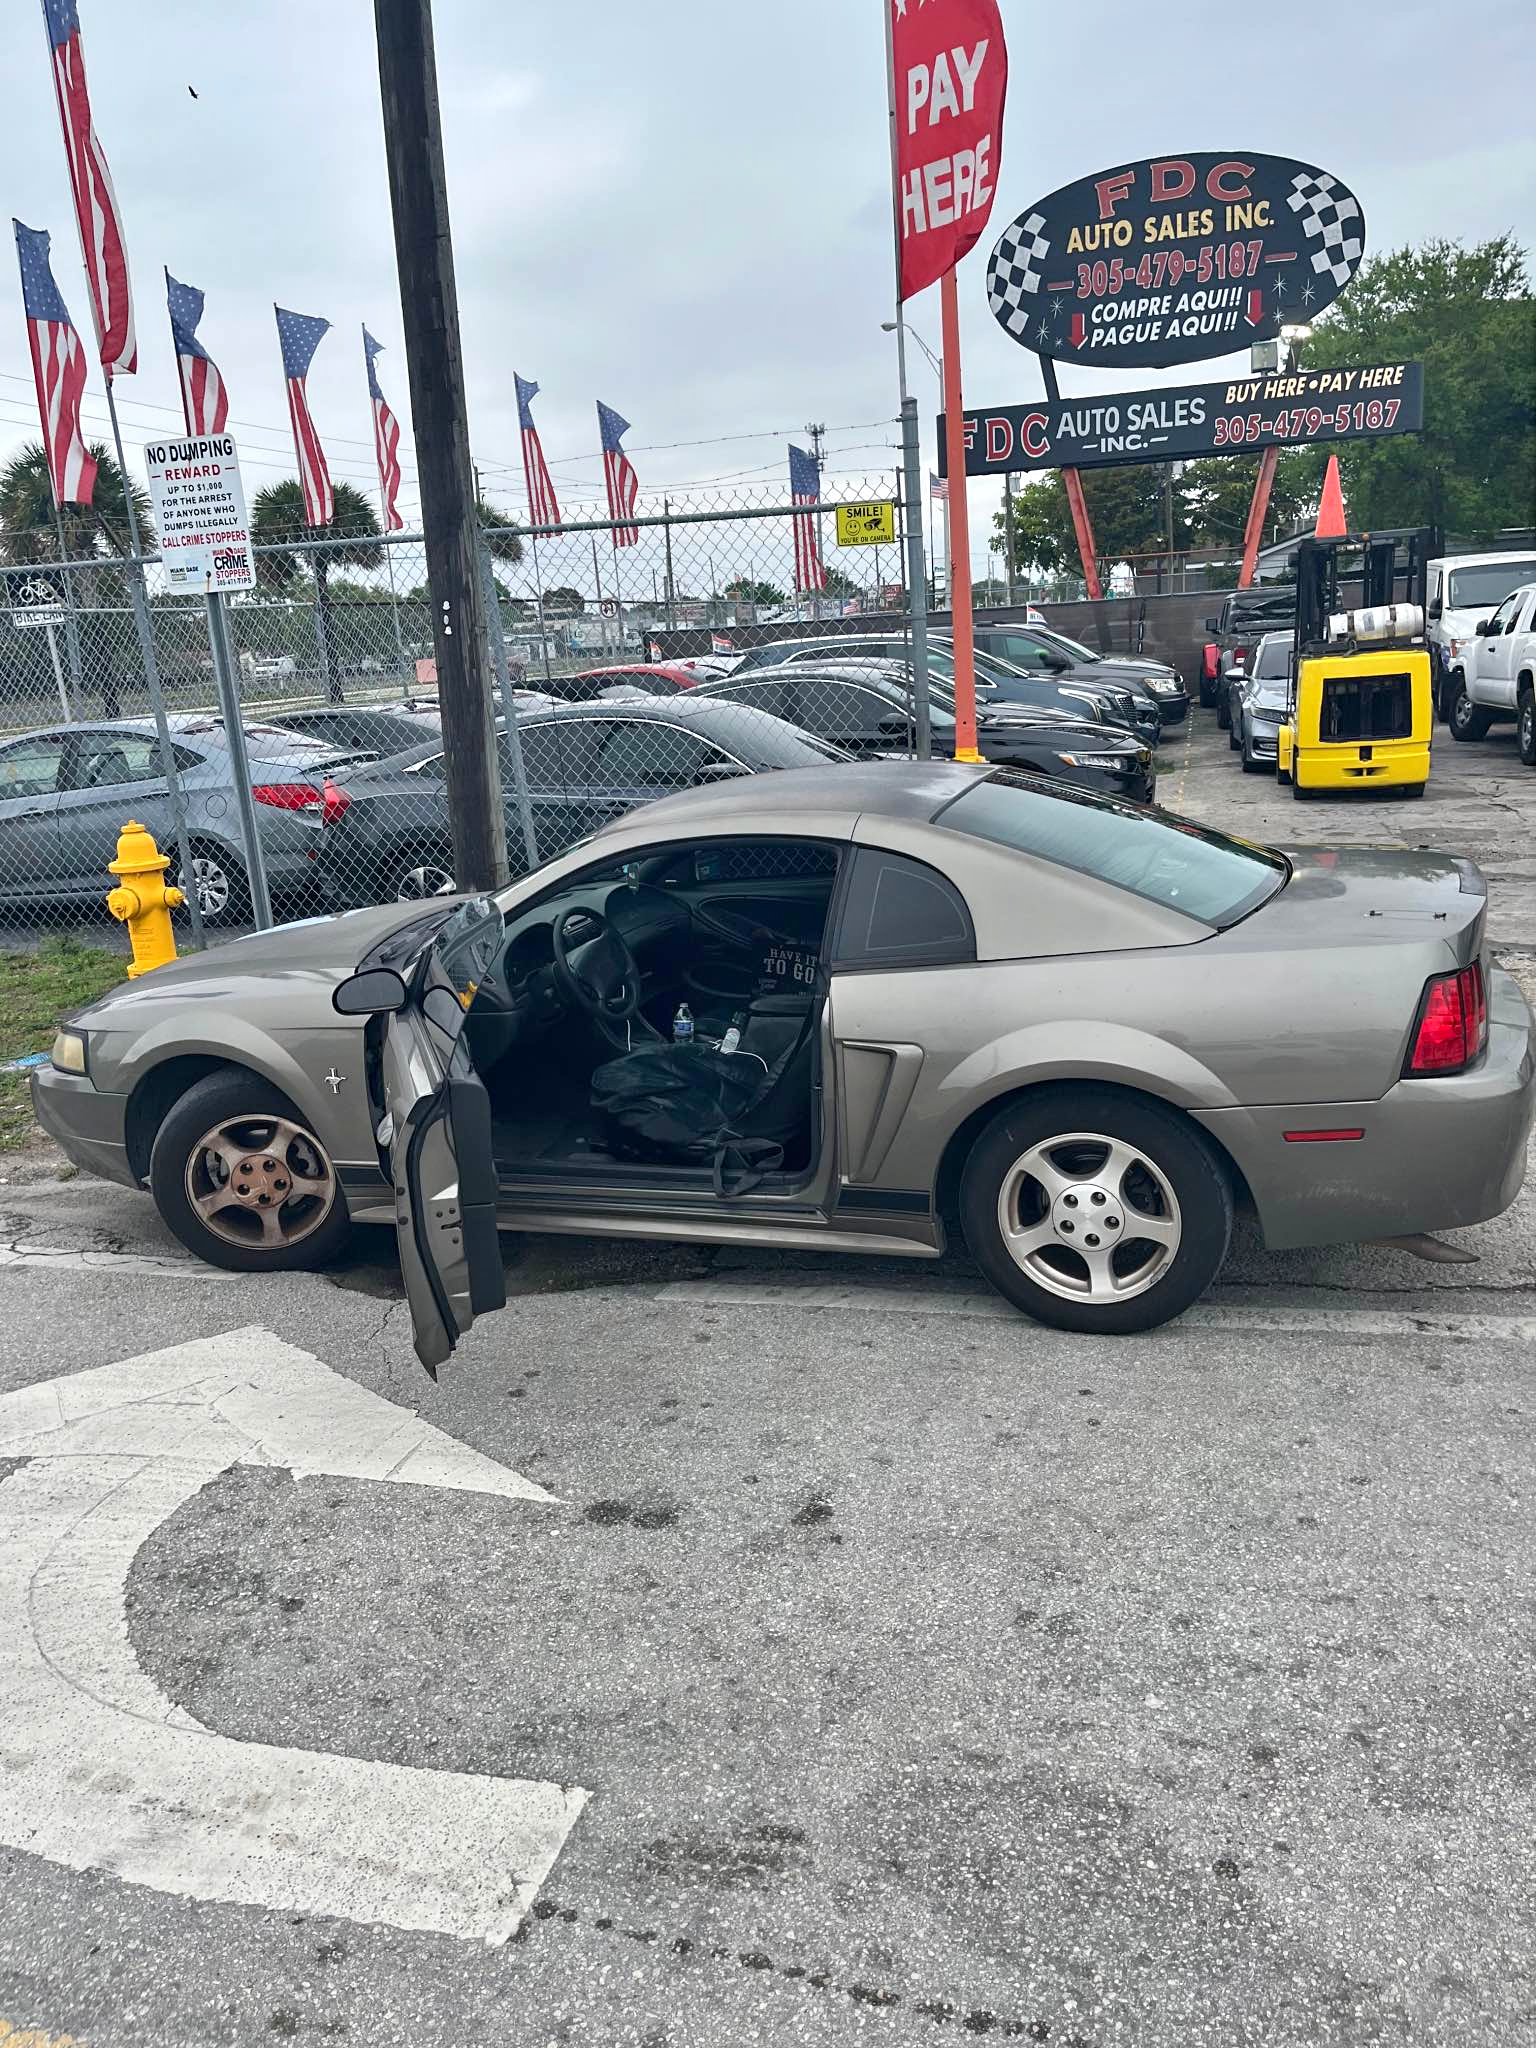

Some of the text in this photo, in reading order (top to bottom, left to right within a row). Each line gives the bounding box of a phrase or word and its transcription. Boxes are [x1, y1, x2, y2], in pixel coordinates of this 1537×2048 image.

[907, 39, 989, 136] PAY
[901, 134, 993, 240] HERE
[1066, 200, 1275, 254] AUTO SALES INC.
[1076, 239, 1263, 299] 305-479-5187
[1091, 286, 1243, 324] COMPRE AQUI!!
[1090, 311, 1239, 348] PAGUE AQUI!!
[1225, 381, 1262, 404] BUY
[1359, 366, 1405, 389] HERE
[1056, 397, 1207, 440] AUTO SALES
[1213, 399, 1401, 446] 305-479-5187
[147, 438, 233, 465] NO DUMPING
[1100, 435, 1149, 453] INC.
[165, 464, 221, 481] REWARD
[167, 482, 223, 495] UP TO $1,000
[162, 493, 233, 507] FOR THE ARREST
[163, 505, 236, 519] OF ANYONE WHO
[846, 506, 883, 518] SMILE!
[164, 517, 238, 531] DUMPS ILLEGALLY
[162, 530, 247, 548] CALL CRIME STOPPERS
[841, 536, 859, 544] YOU'RE
[214, 554, 249, 570] CRIME
[215, 568, 251, 579] STOPPERS
[768, 948, 817, 967] HAVE IT
[763, 958, 786, 975] TO
[793, 963, 815, 985] GO
